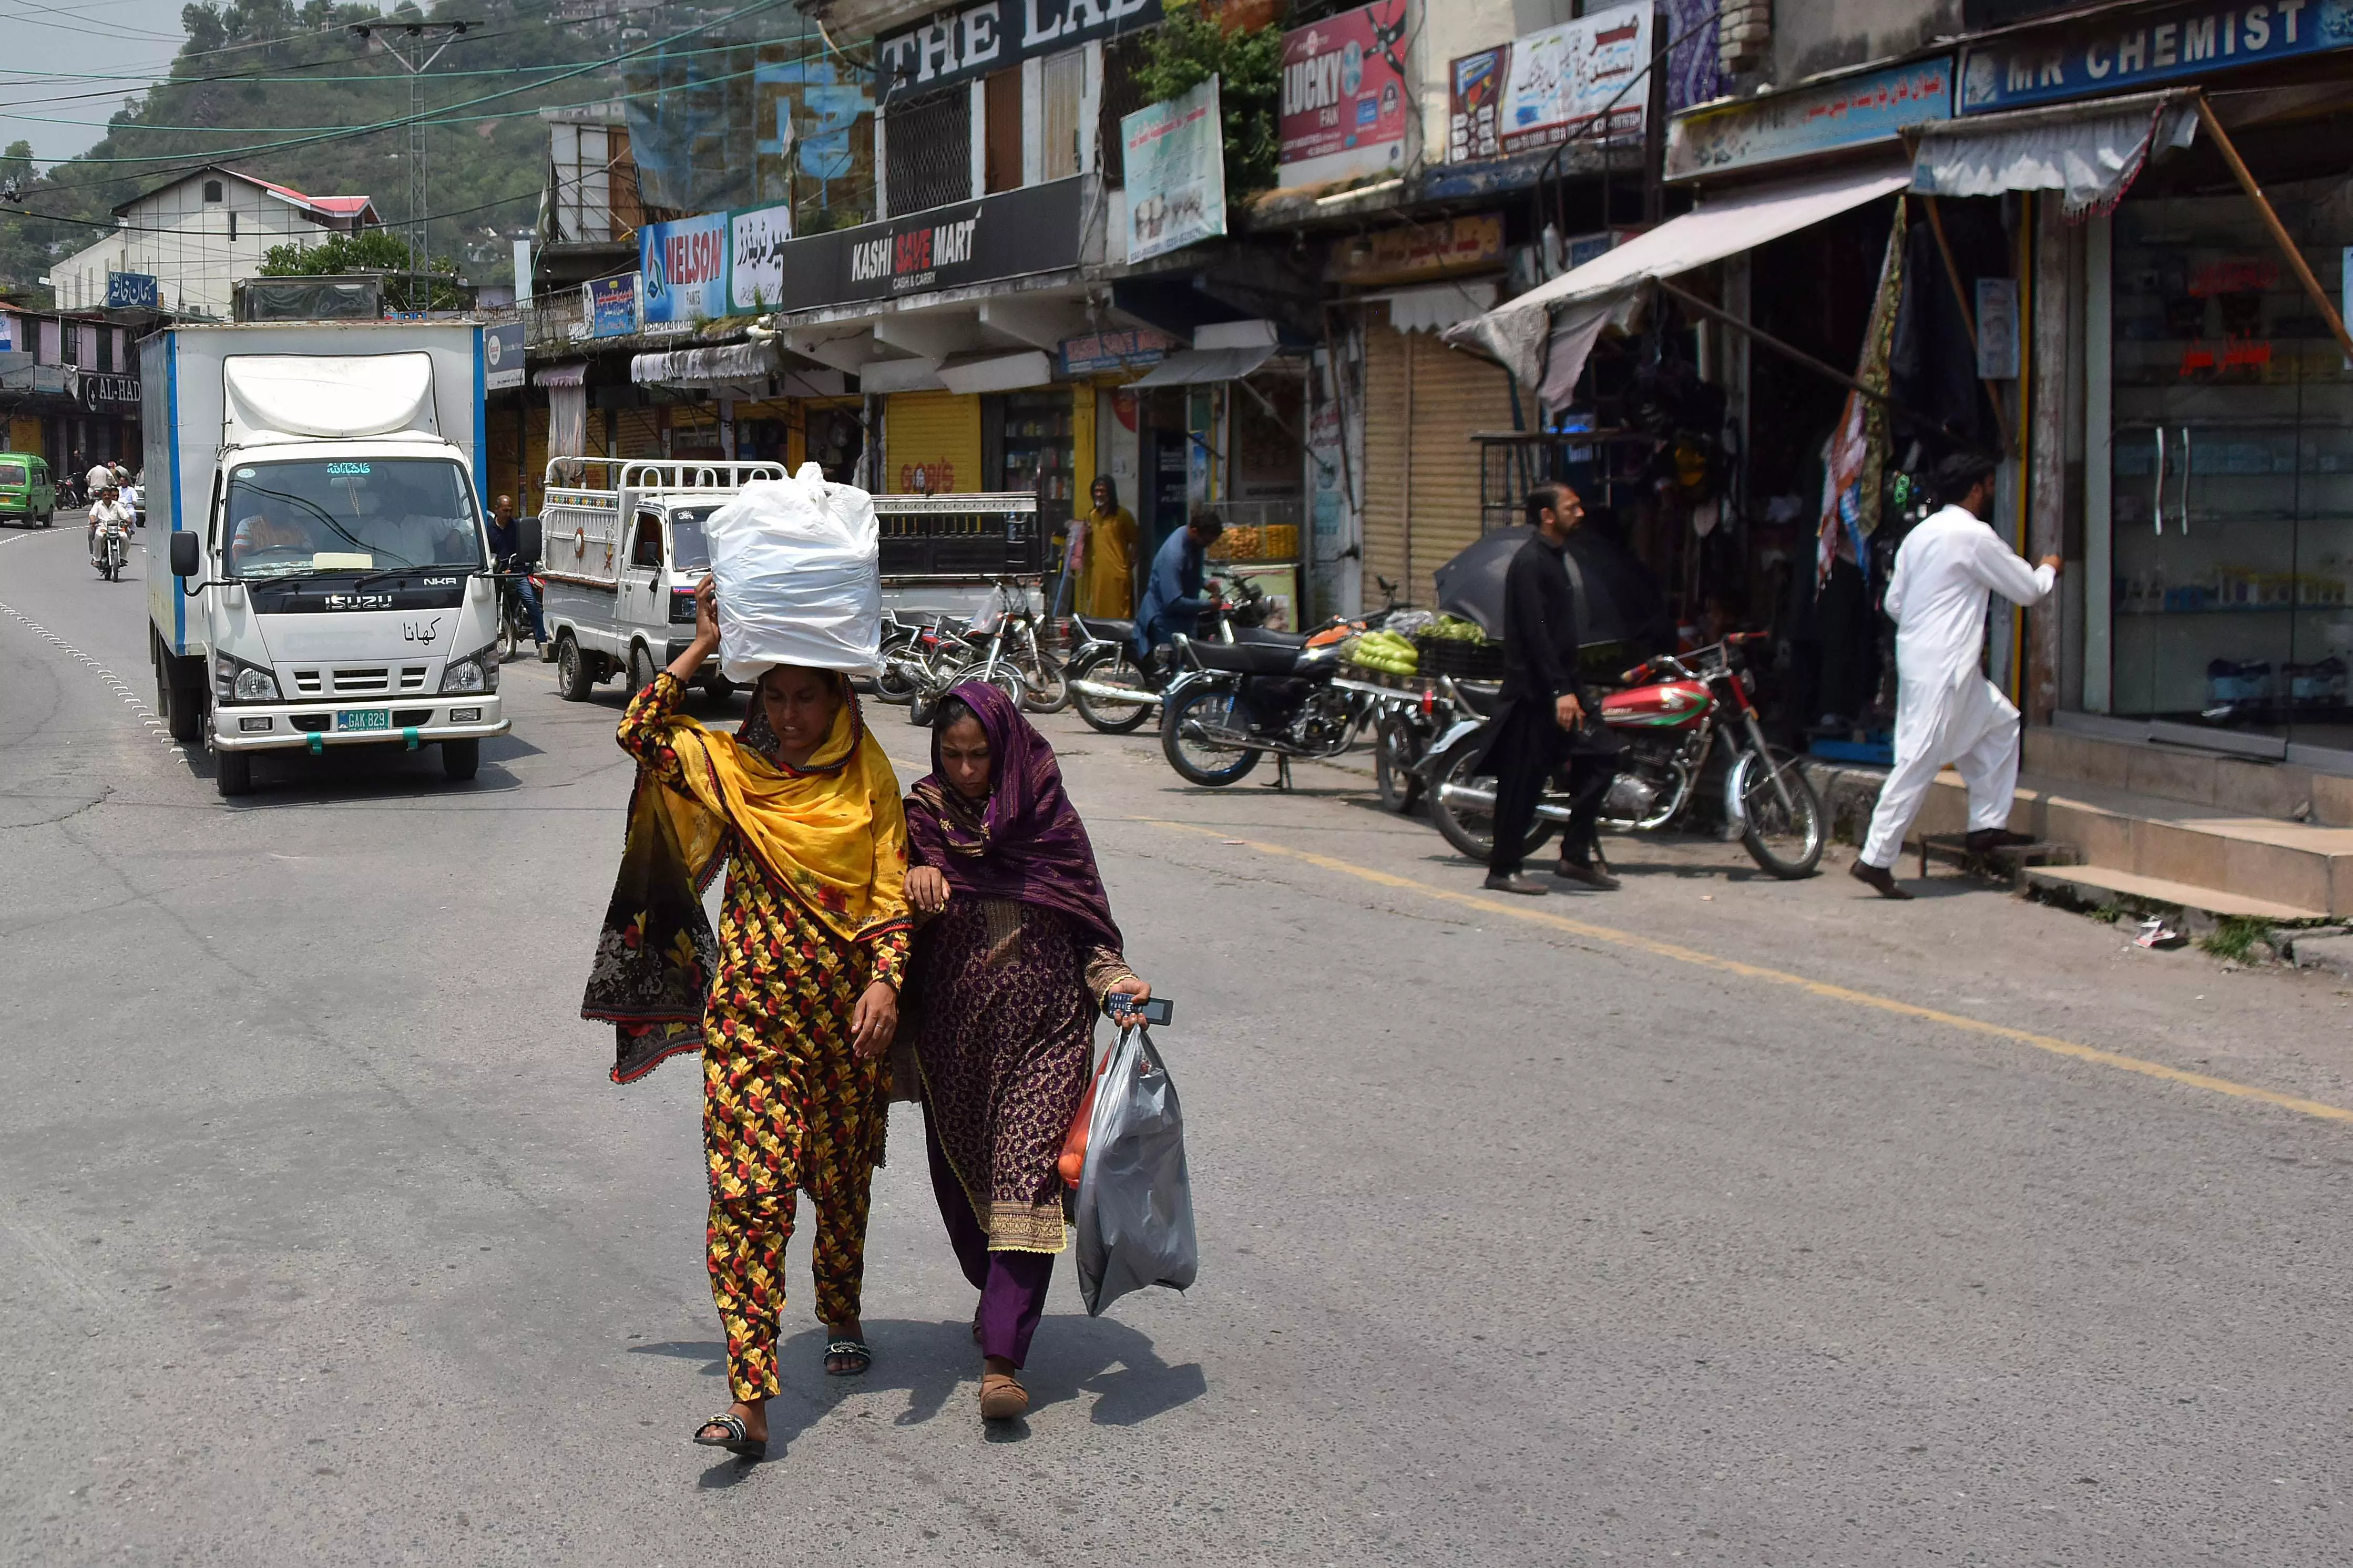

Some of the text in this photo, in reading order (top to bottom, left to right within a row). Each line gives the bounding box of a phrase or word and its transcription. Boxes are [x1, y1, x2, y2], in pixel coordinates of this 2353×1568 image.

[882, 1, 1001, 91] THE
[2086, 0, 2306, 79] CHEMIST
[1283, 49, 1342, 117] LUCKY
[665, 228, 723, 285] NELSON
[852, 218, 977, 282] KASHI SAVE MART
[110, 273, 120, 282] MK
[893, 271, 936, 290] CASH & CARRY
[325, 595, 392, 610] ISUZU
[403, 616, 442, 647] کھانا
[349, 712, 385, 727] GAK 829
